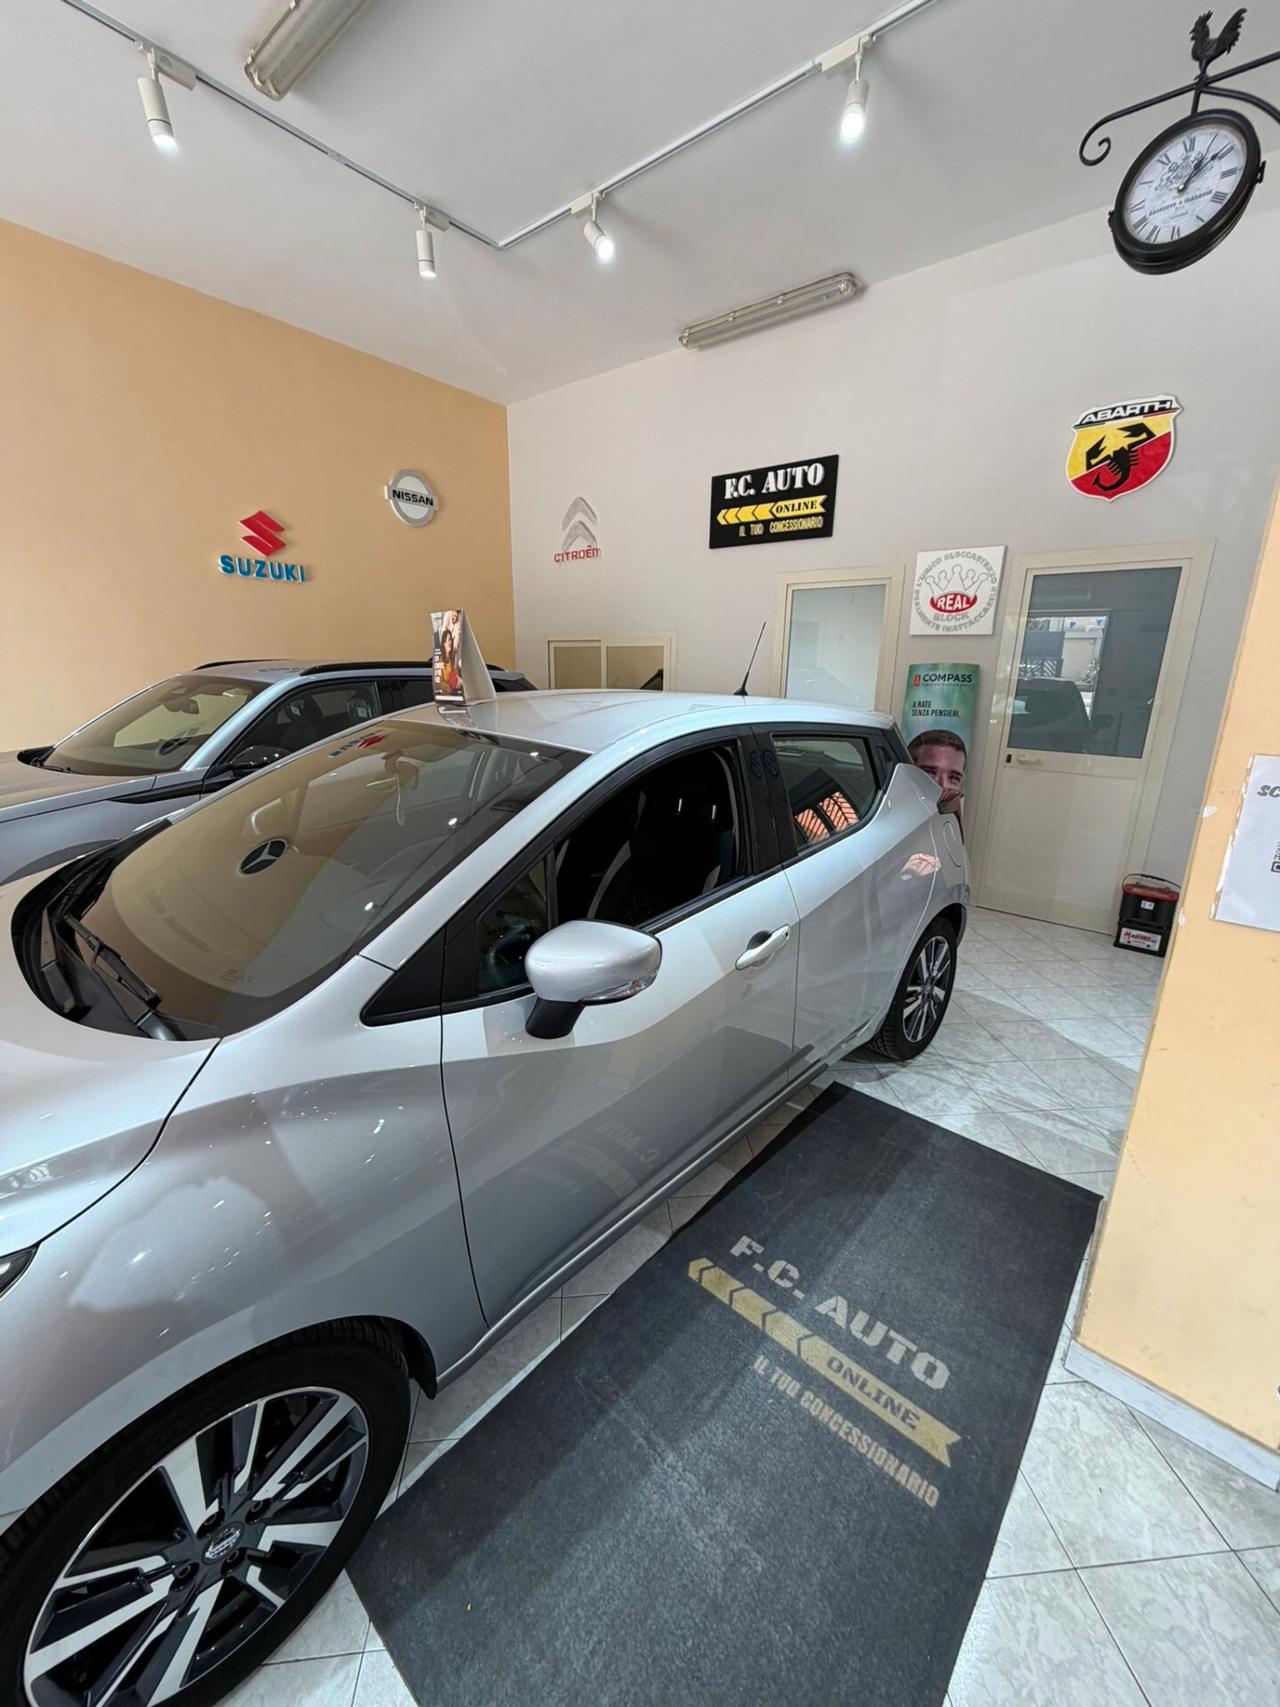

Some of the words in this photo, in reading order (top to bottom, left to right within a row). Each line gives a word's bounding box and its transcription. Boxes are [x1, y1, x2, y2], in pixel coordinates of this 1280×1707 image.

[1080, 401, 1172, 424] ABARTH
[761, 462, 825, 493] AUTO
[392, 489, 434, 507] NISSAN
[775, 500, 818, 514] ONLINE
[750, 523, 765, 536] TUO
[769, 516, 824, 534] CONCESSIONARIO
[218, 554, 305, 583] SUZUKI
[937, 594, 970, 611] REAL
[933, 613, 970, 622] BLOCK
[922, 673, 973, 683] COMPASS
[911, 709, 930, 717] SENZA
[917, 700, 932, 708] RATE
[730, 1235, 806, 1300] F.C.
[814, 1295, 950, 1390] AUTO
[825, 1356, 920, 1430] ONLINE
[753, 1355, 770, 1374] IL
[769, 1366, 801, 1398] TUO
[800, 1390, 940, 1509] CONCESSIONARIO
